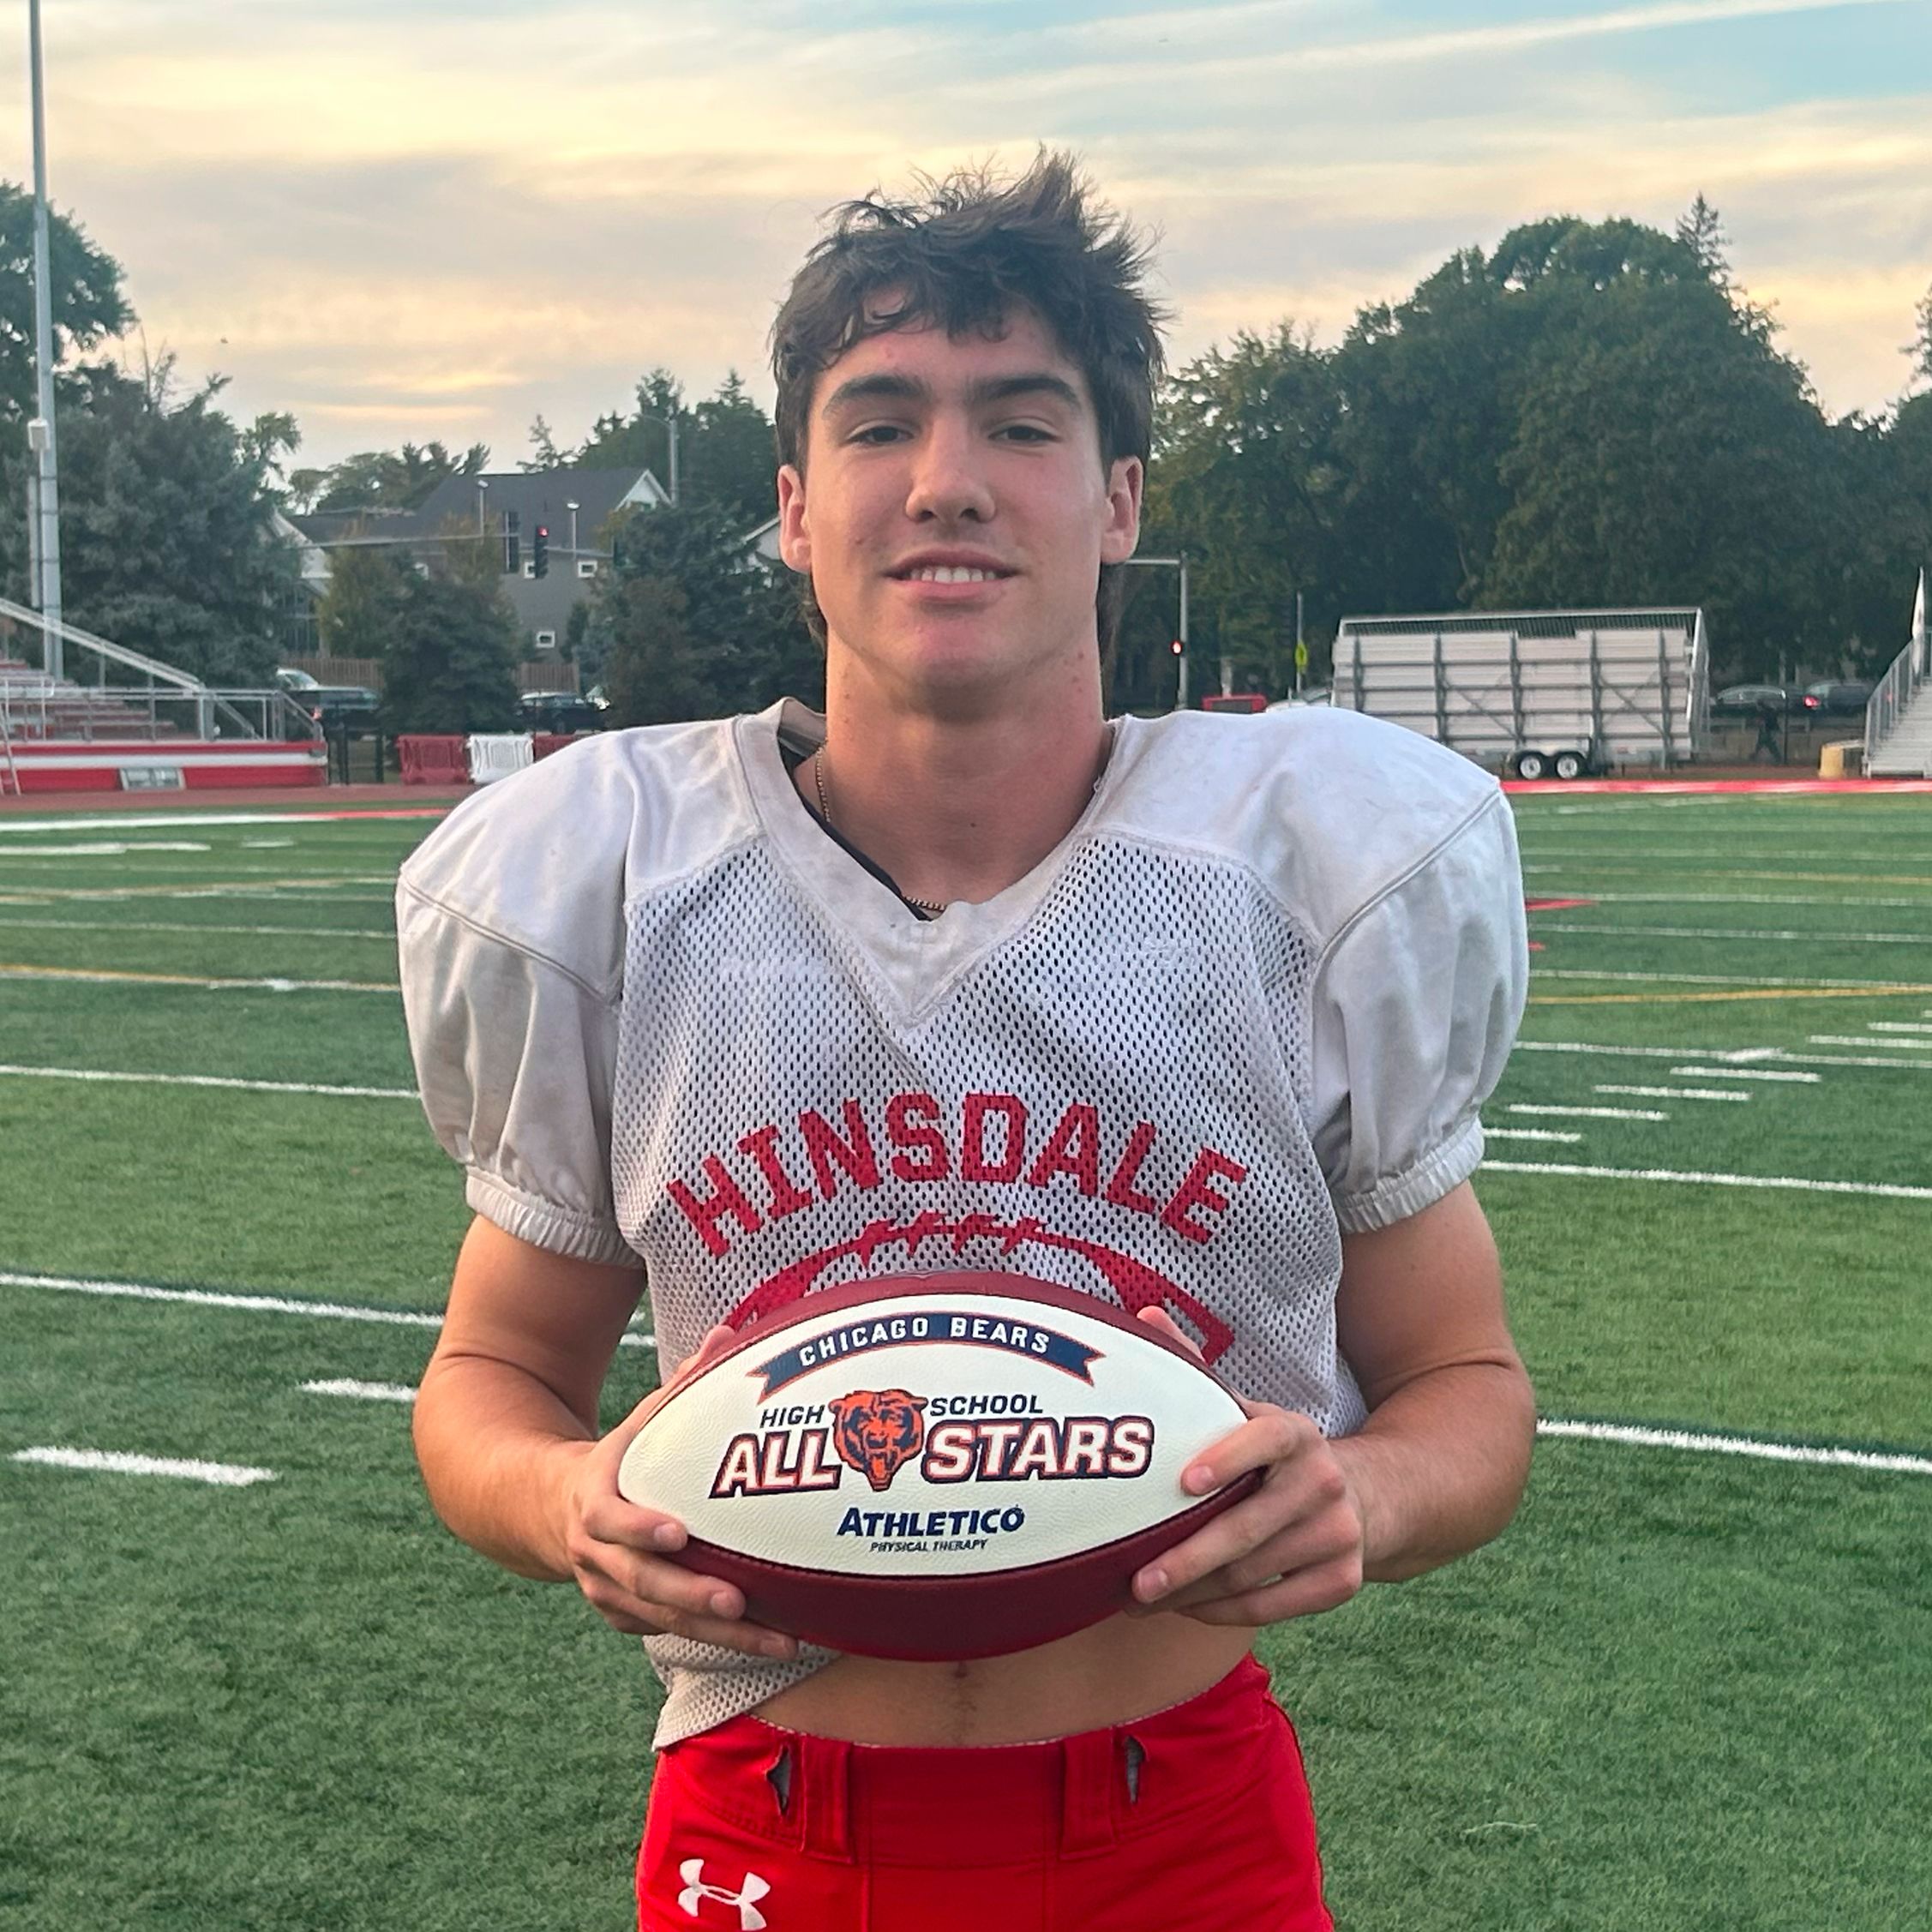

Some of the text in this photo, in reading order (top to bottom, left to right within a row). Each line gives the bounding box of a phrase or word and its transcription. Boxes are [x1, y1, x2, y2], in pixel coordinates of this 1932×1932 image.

[666, 1093, 1247, 1258] HINSDALE
[798, 1317, 1050, 1367] CHICAGO BEARS
[759, 1394, 1043, 1428] HIGH SCHOOL
[708, 1415, 1155, 1499] ALL STARS
[837, 1506, 1025, 1537] ATHLETICO
[870, 1539, 988, 1552] PHYSICAL THERAPY
